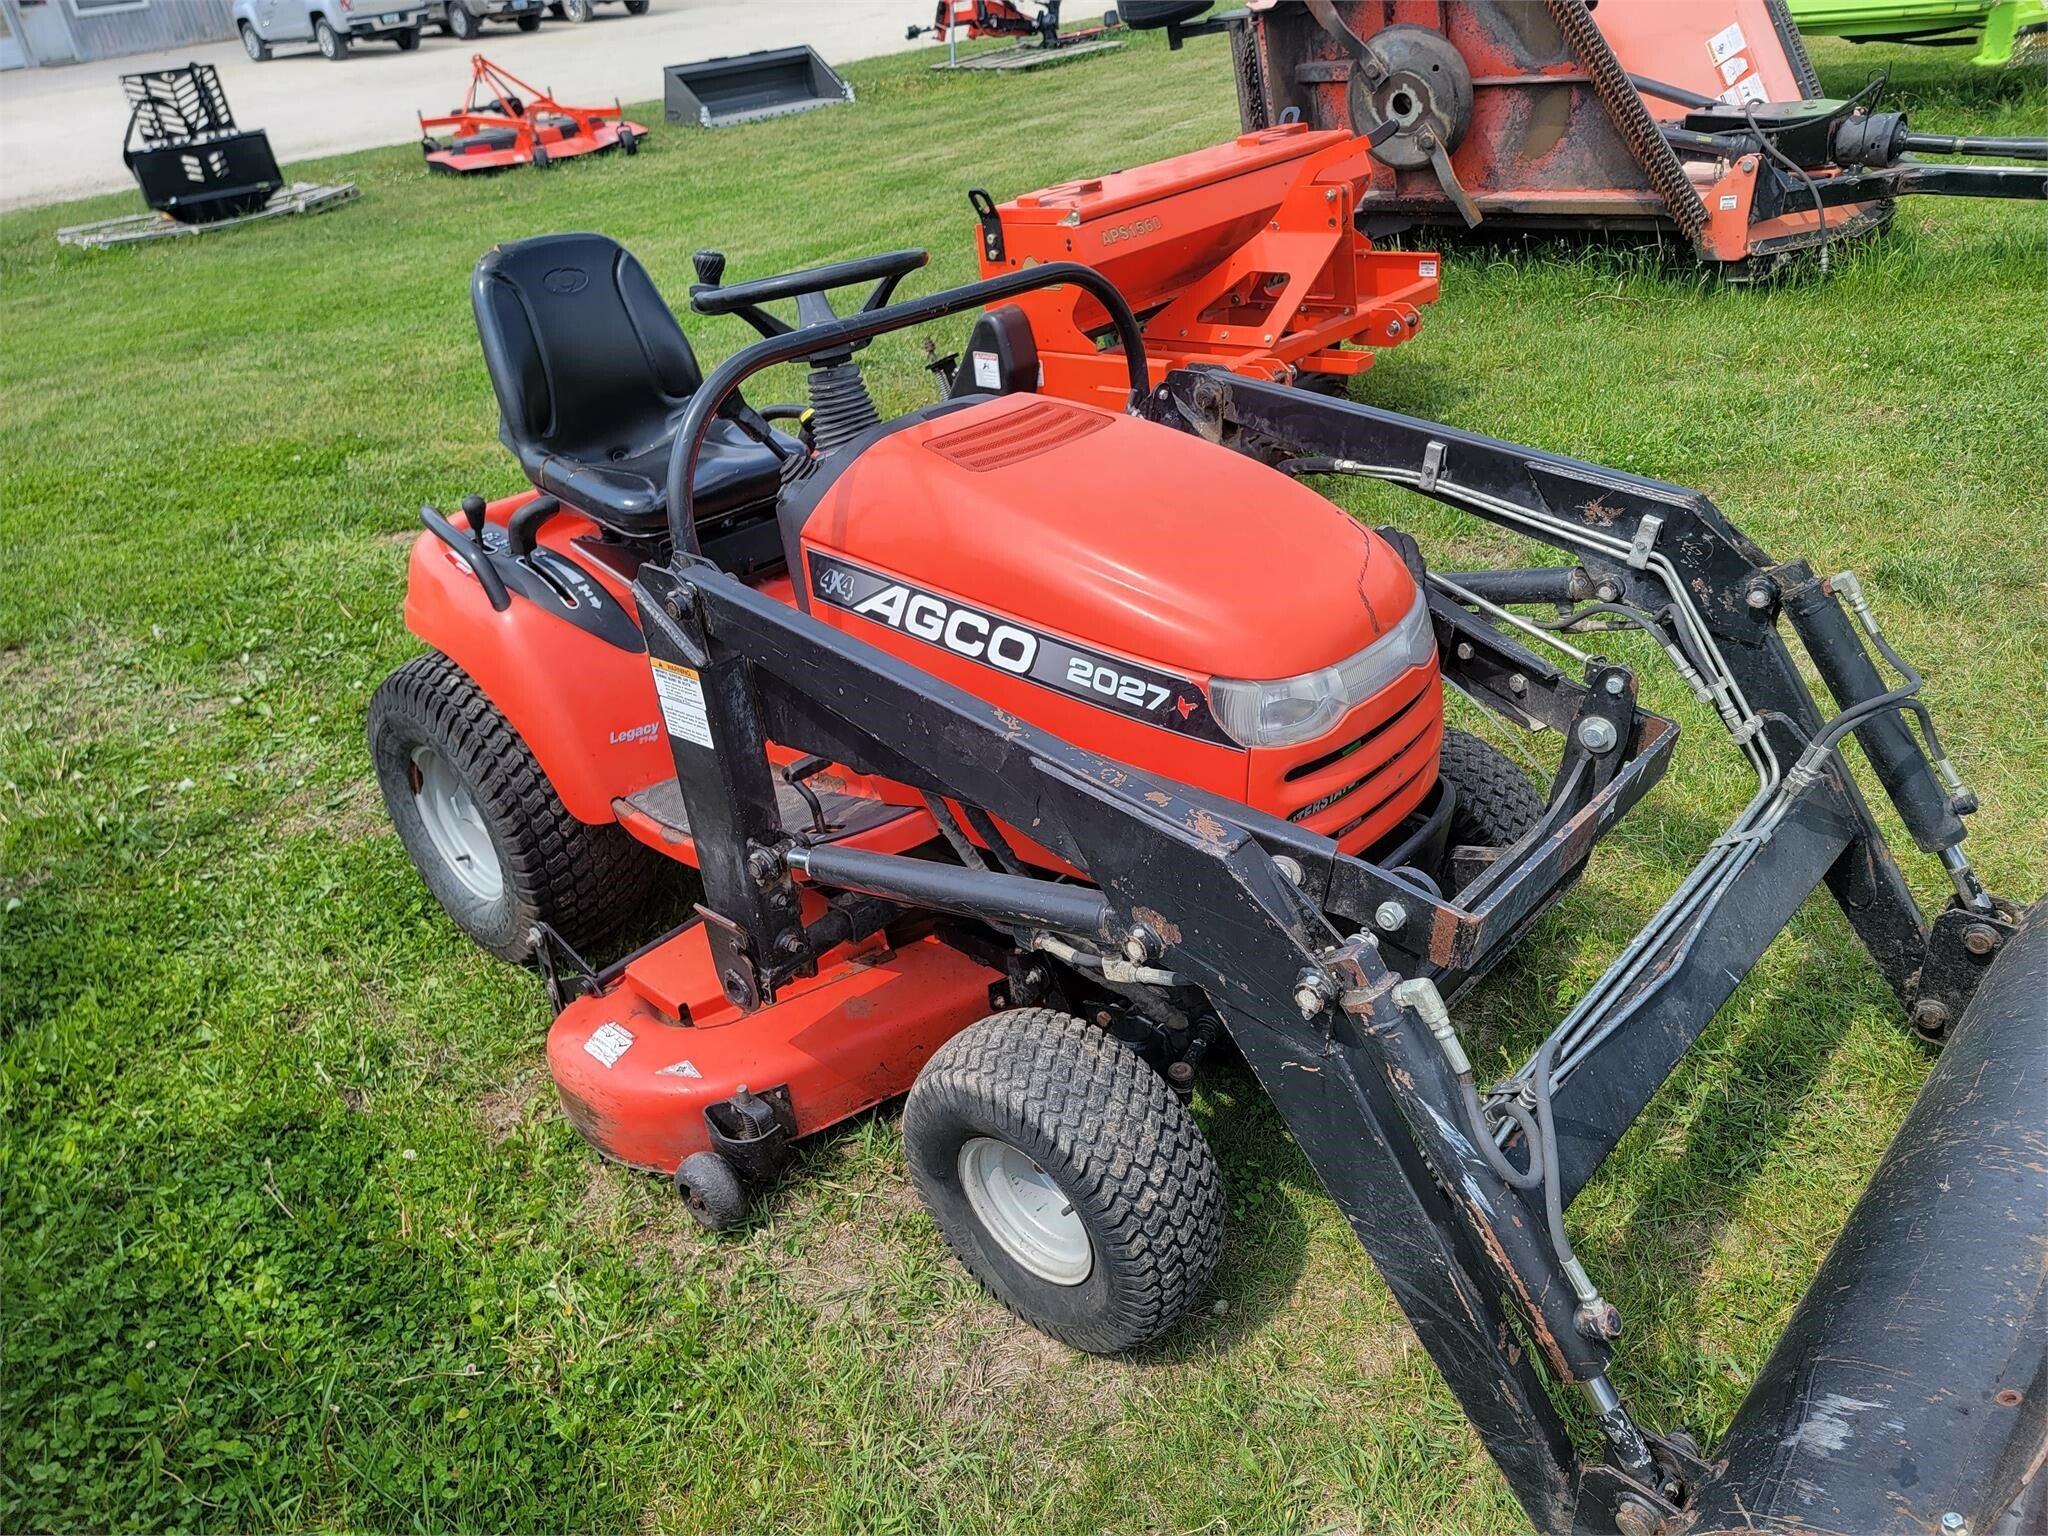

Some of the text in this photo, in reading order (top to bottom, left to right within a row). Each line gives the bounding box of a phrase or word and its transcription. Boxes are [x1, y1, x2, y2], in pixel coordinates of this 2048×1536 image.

[1102, 216, 1161, 246] APS1560
[852, 585, 1038, 674] AGCO
[1066, 657, 1171, 711] 2027
[609, 721, 660, 744] Legacy
